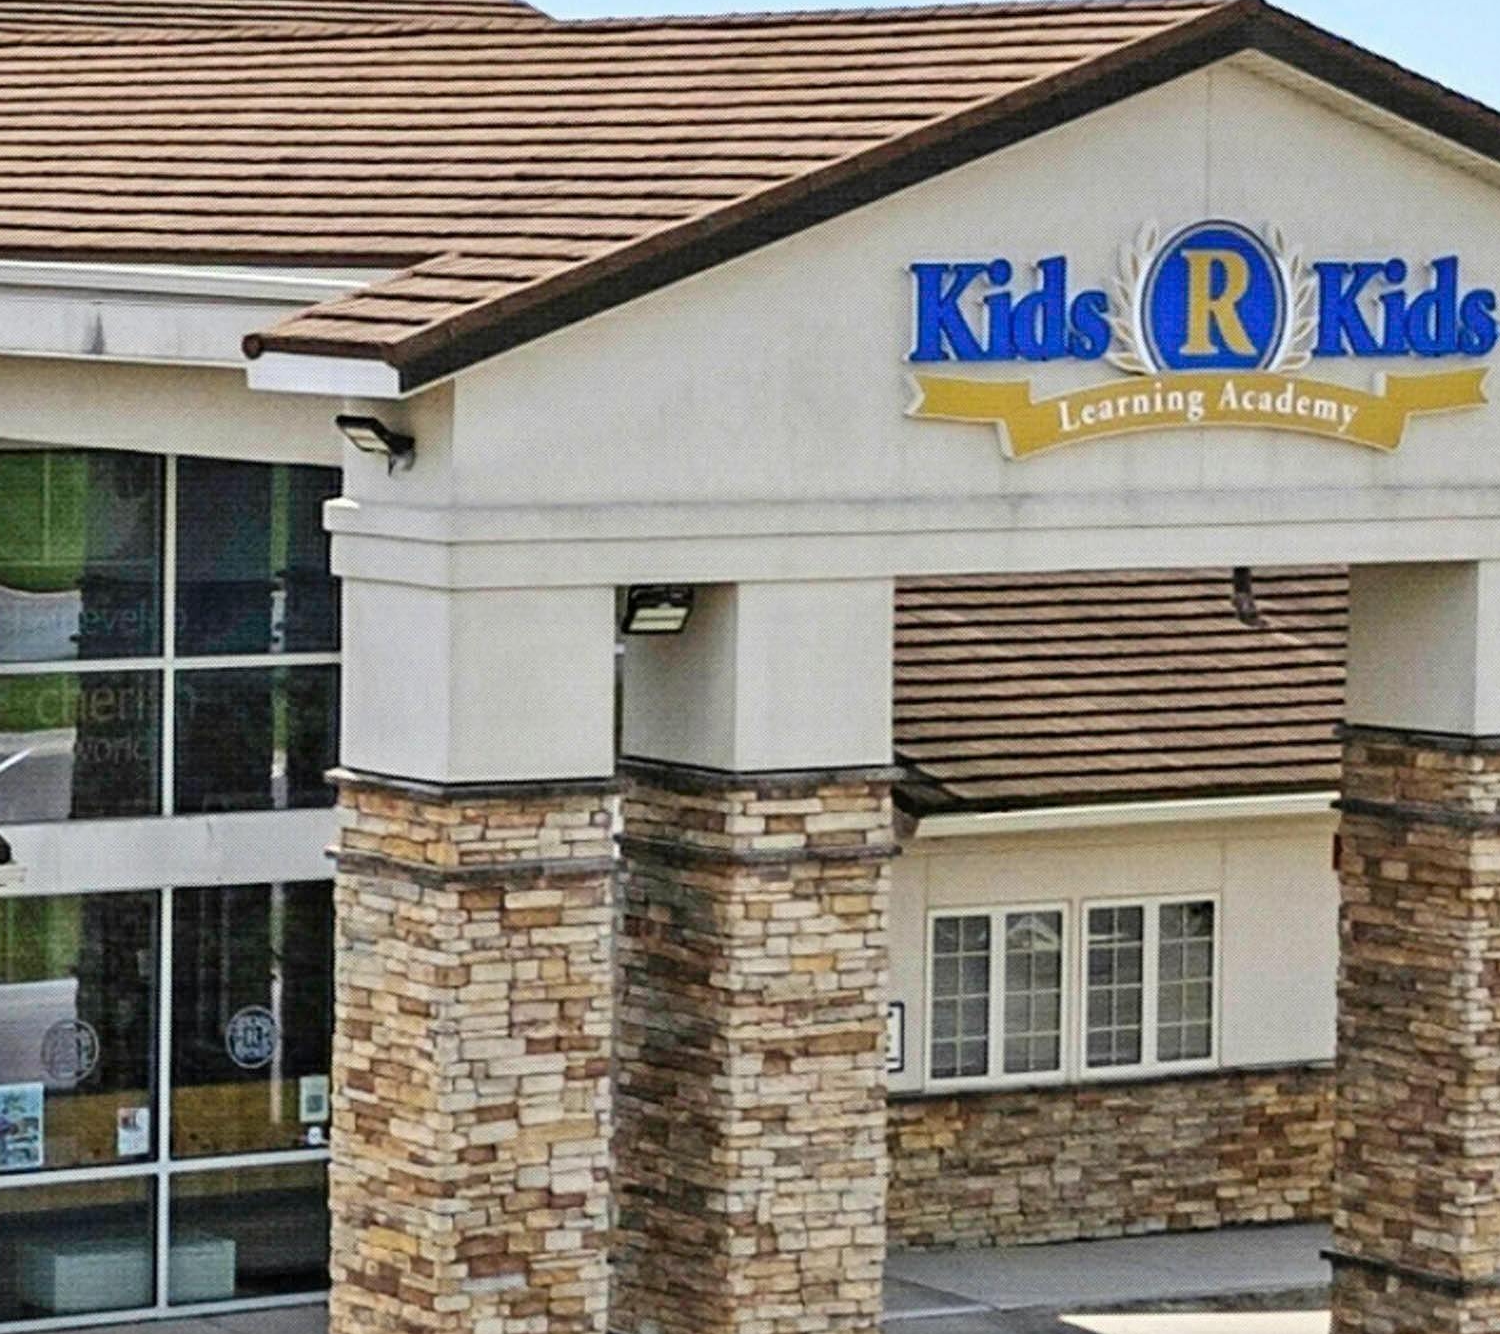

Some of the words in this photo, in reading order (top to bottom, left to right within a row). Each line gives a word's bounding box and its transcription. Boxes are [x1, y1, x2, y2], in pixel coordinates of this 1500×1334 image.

[908, 254, 1112, 362] Kids
[1180, 249, 1257, 356] R
[1312, 254, 1499, 358] Kids
[1058, 381, 1205, 432] Learning
[1218, 378, 1359, 433] Academy
